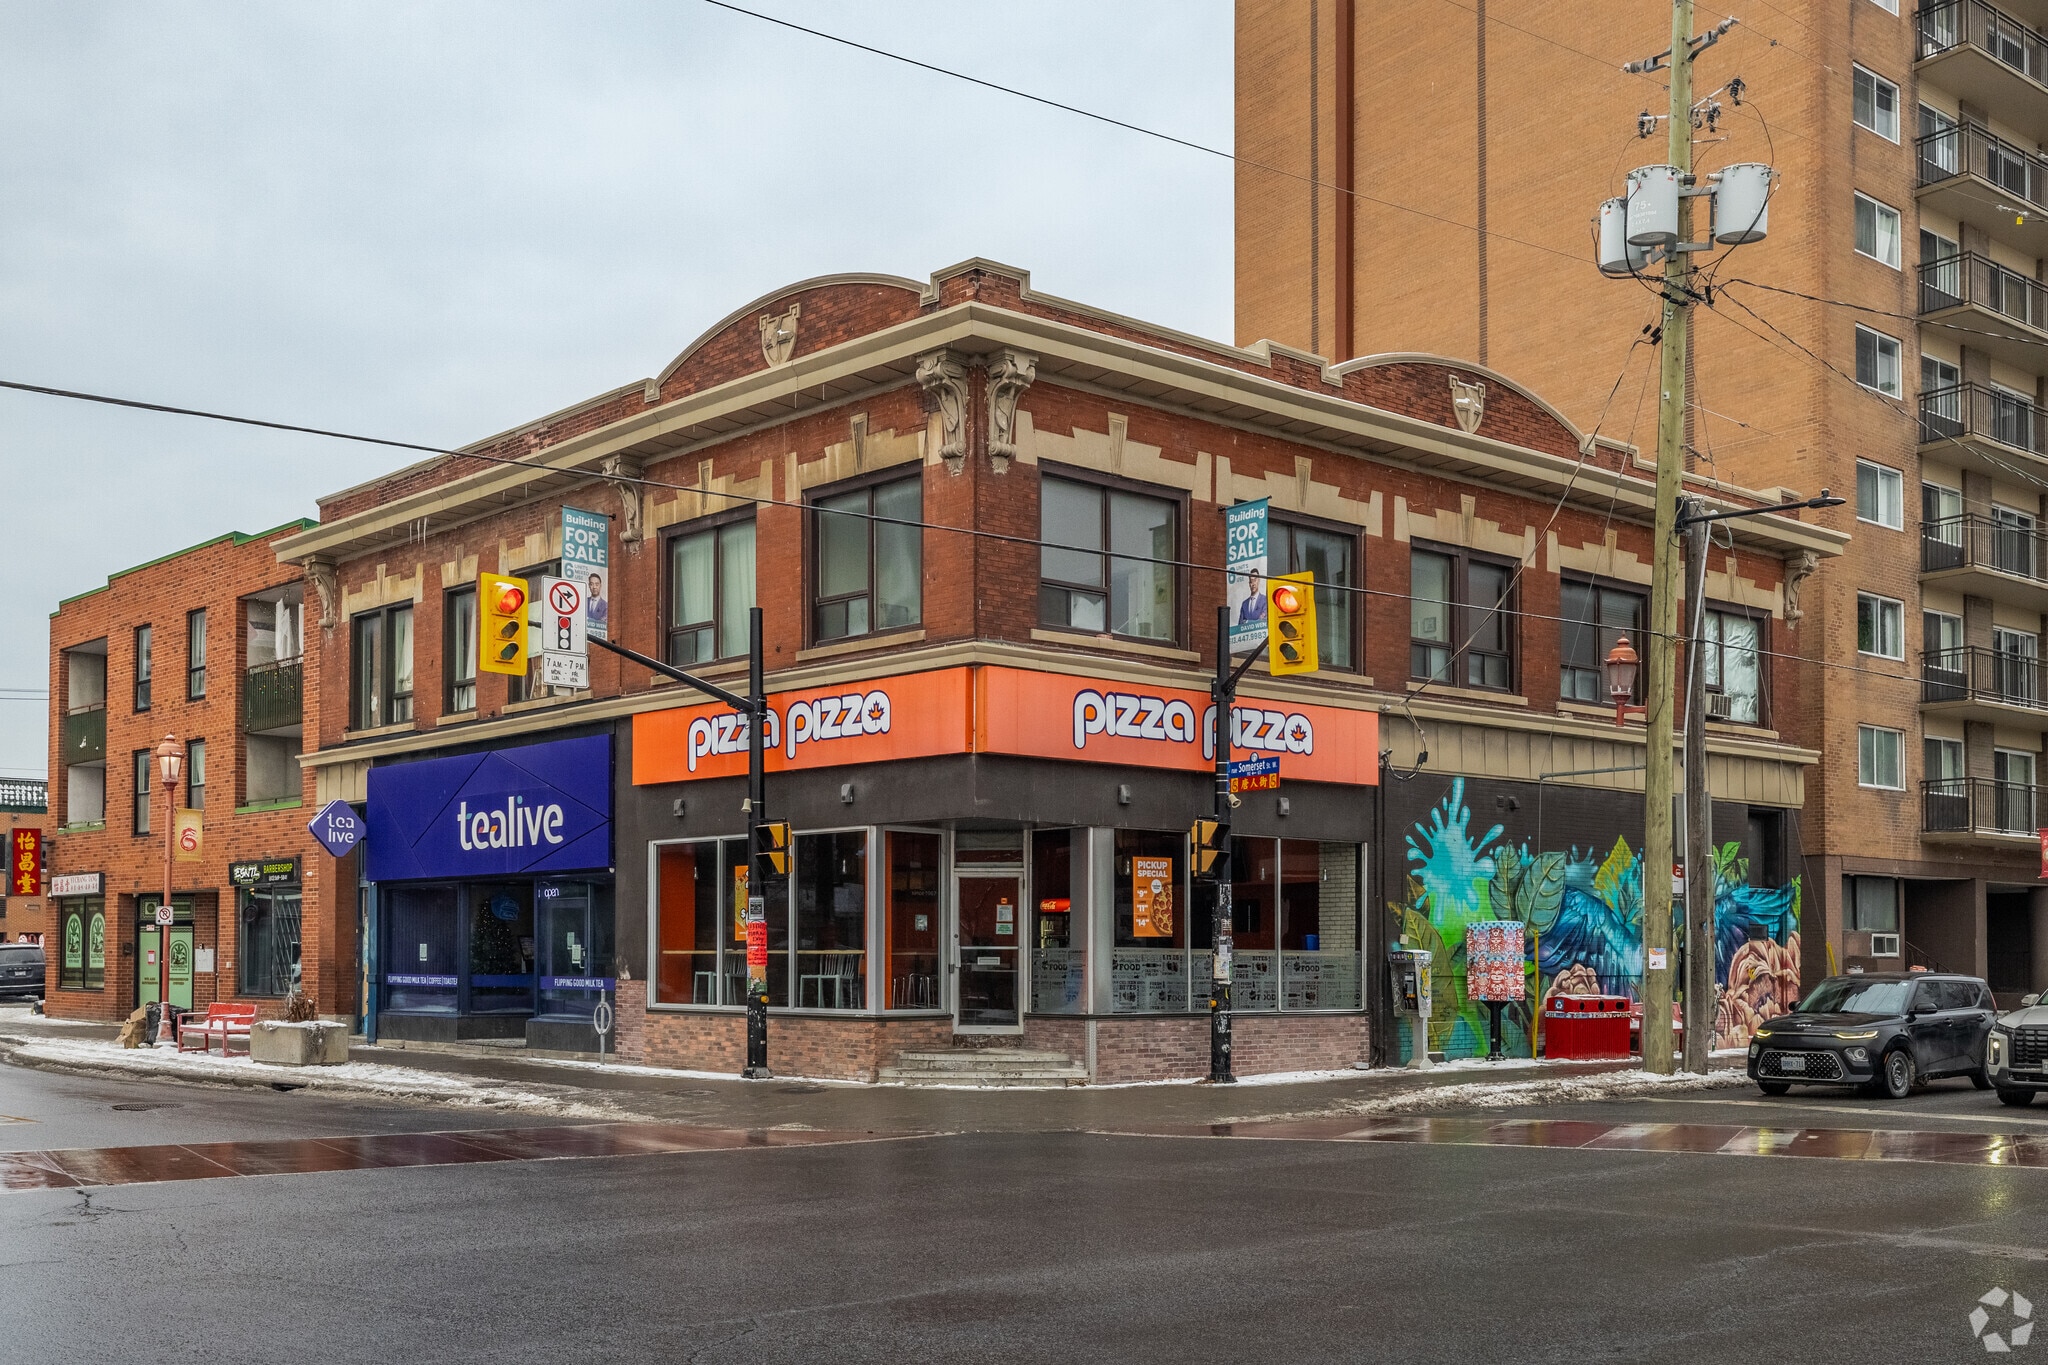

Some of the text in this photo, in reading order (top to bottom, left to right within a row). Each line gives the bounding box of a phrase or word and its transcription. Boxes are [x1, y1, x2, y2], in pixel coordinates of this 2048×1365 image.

[566, 514, 606, 532] Building
[1229, 507, 1264, 524] Building
[566, 527, 599, 547] FOR
[1229, 522, 1258, 544] FOR
[564, 543, 606, 564] SALE
[1229, 538, 1264, 562] SALE
[564, 562, 574, 578] 6
[1241, 624, 1254, 632] DAVID
[547, 658, 550, 666] 7
[569, 660, 574, 668] 7
[576, 662, 585, 670] P.M.
[1073, 689, 1195, 749] pizza
[688, 690, 891, 772] pizza pizza
[1238, 760, 1265, 772] Somerset
[1241, 776, 1267, 790] 唐人街
[327, 813, 354, 828] tea
[457, 795, 564, 851] tealive
[328, 829, 354, 844] live
[17, 832, 36, 894] 怡昌堂
[263, 863, 292, 874] BARBERSHOP
[1138, 861, 1168, 869] PICKUP
[544, 888, 559, 899] open
[555, 978, 604, 987] FLIPPING GOOD MILK TEA
